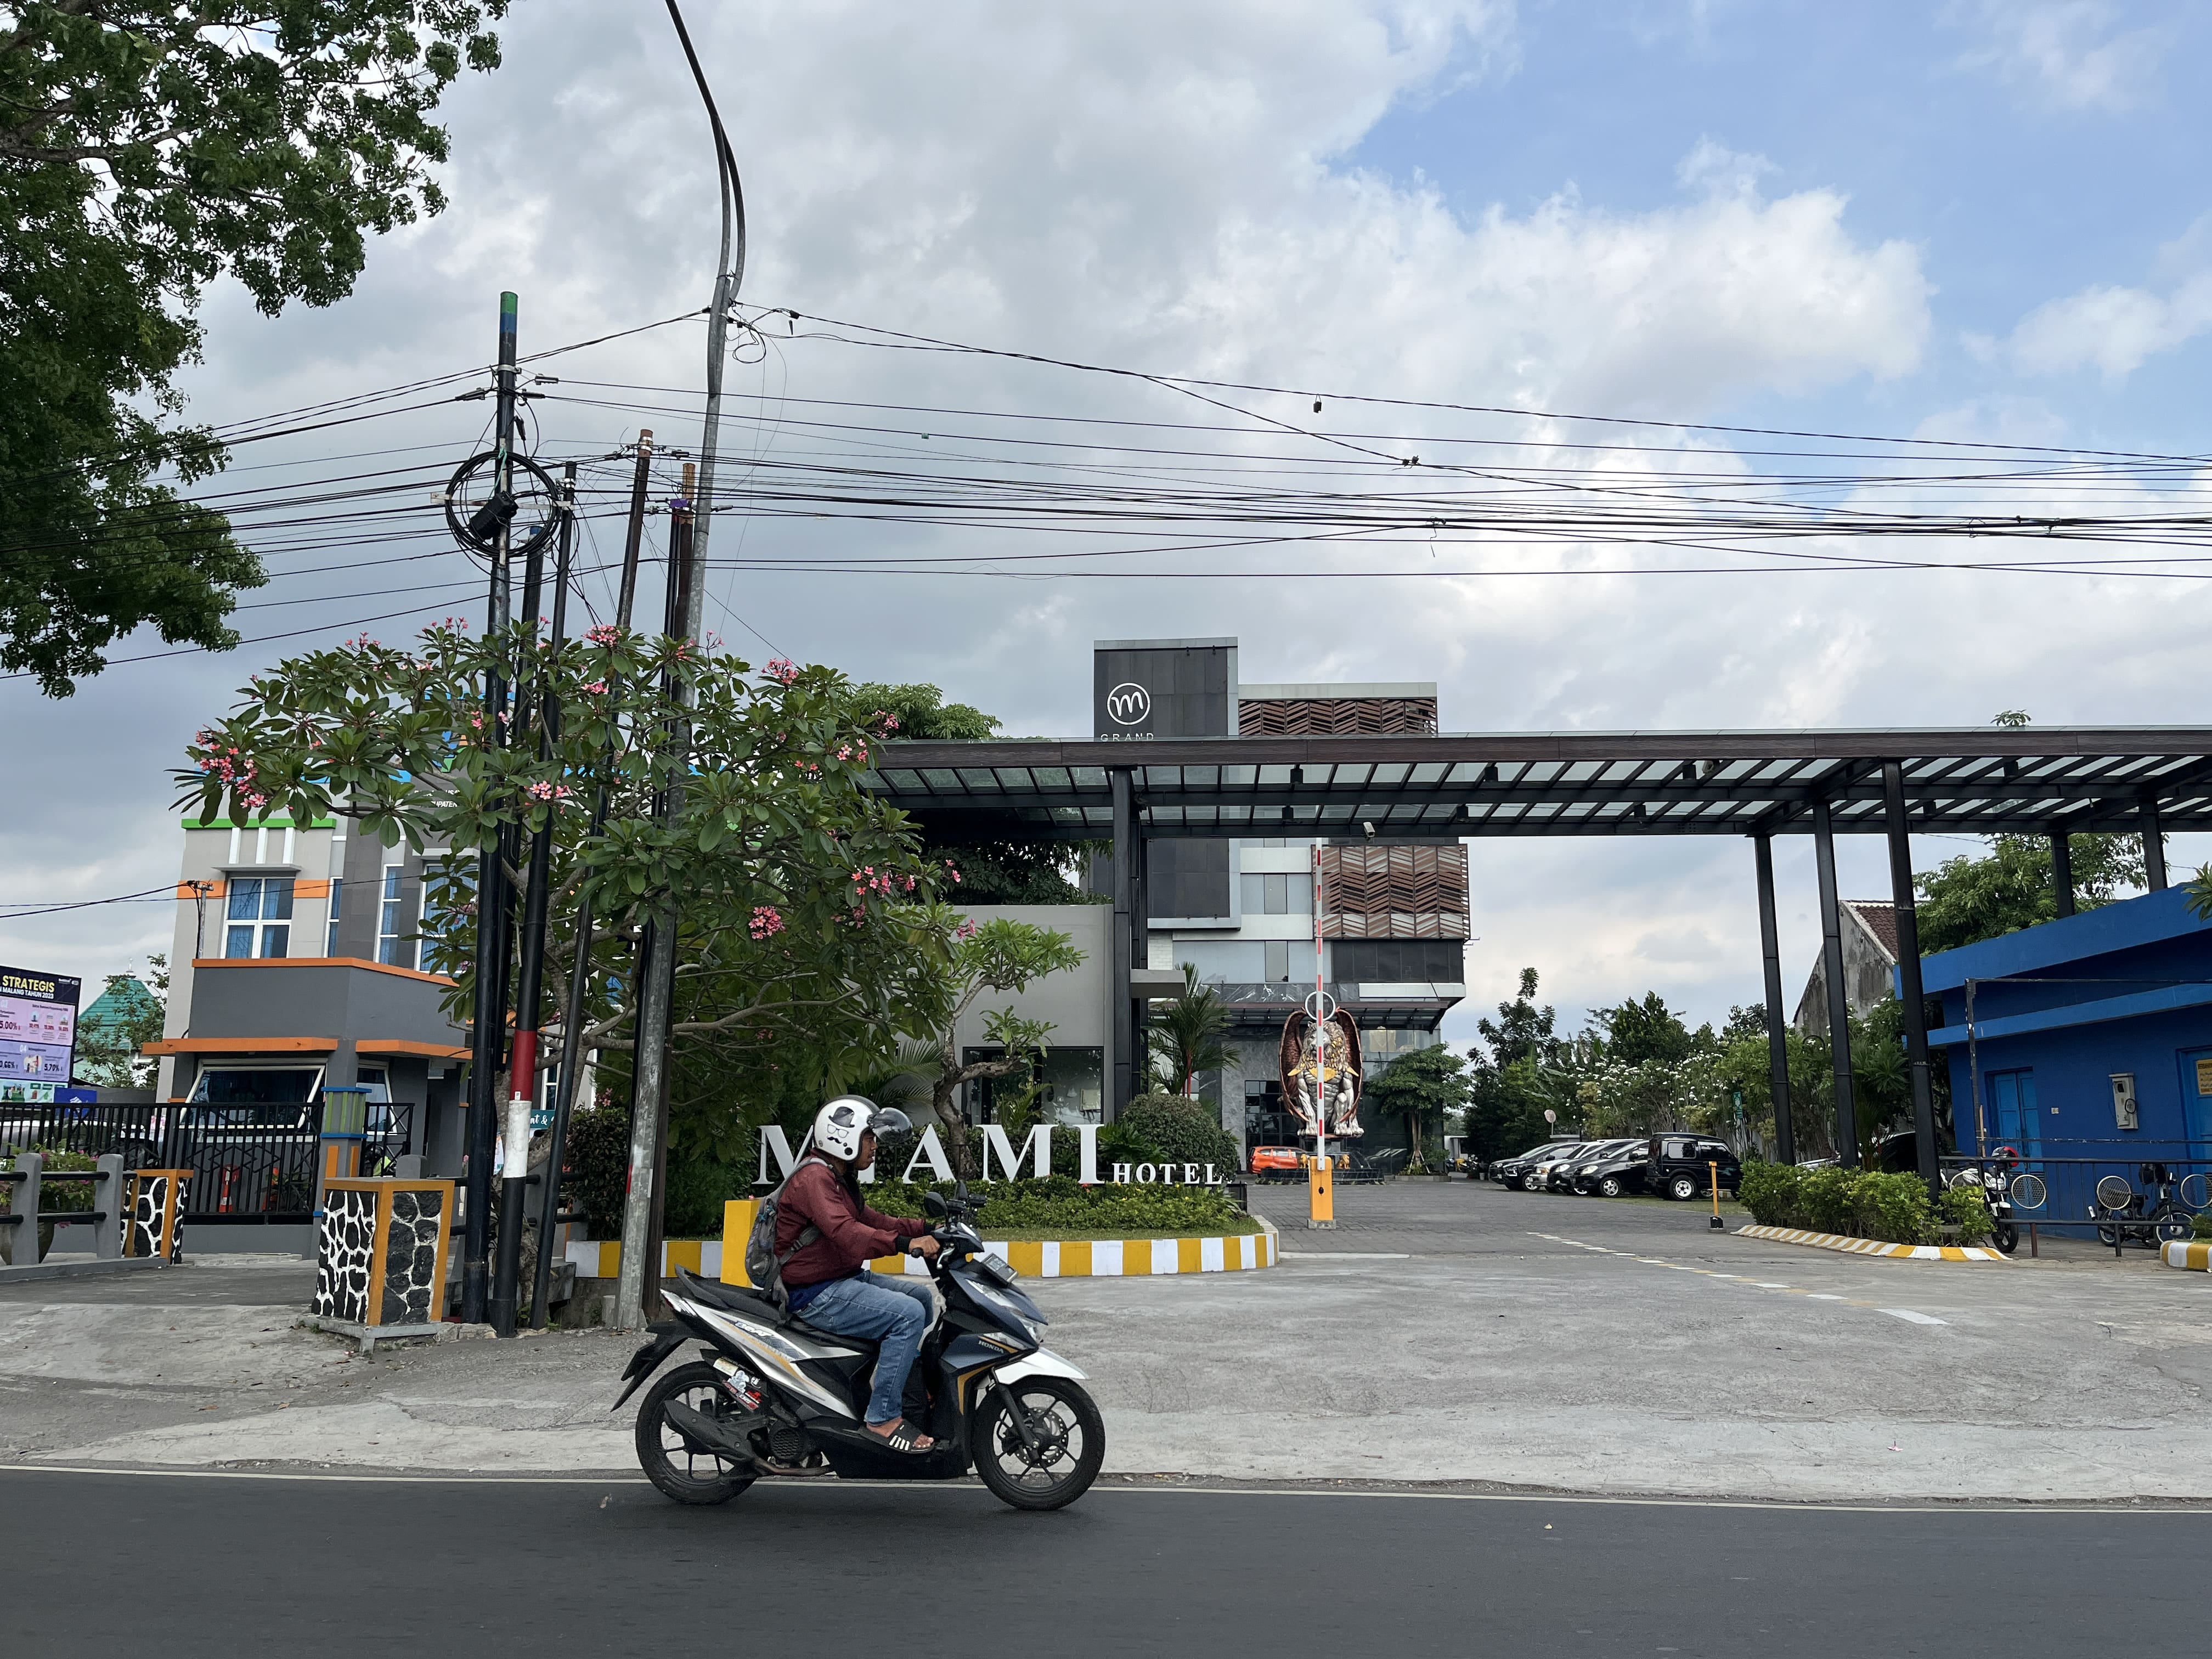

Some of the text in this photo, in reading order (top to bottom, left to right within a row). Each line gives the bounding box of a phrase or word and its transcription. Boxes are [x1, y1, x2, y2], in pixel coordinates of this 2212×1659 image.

[1101, 732, 1154, 742] GRAND
[2, 975, 55, 992] STRATEGIS
[2, 987, 24, 995] MALANG
[25, 990, 42, 998] TAHUN
[541, 1115, 548, 1125] &
[1111, 1163, 1222, 1184] HOTEL
[978, 1340, 1004, 1354] HONDA
